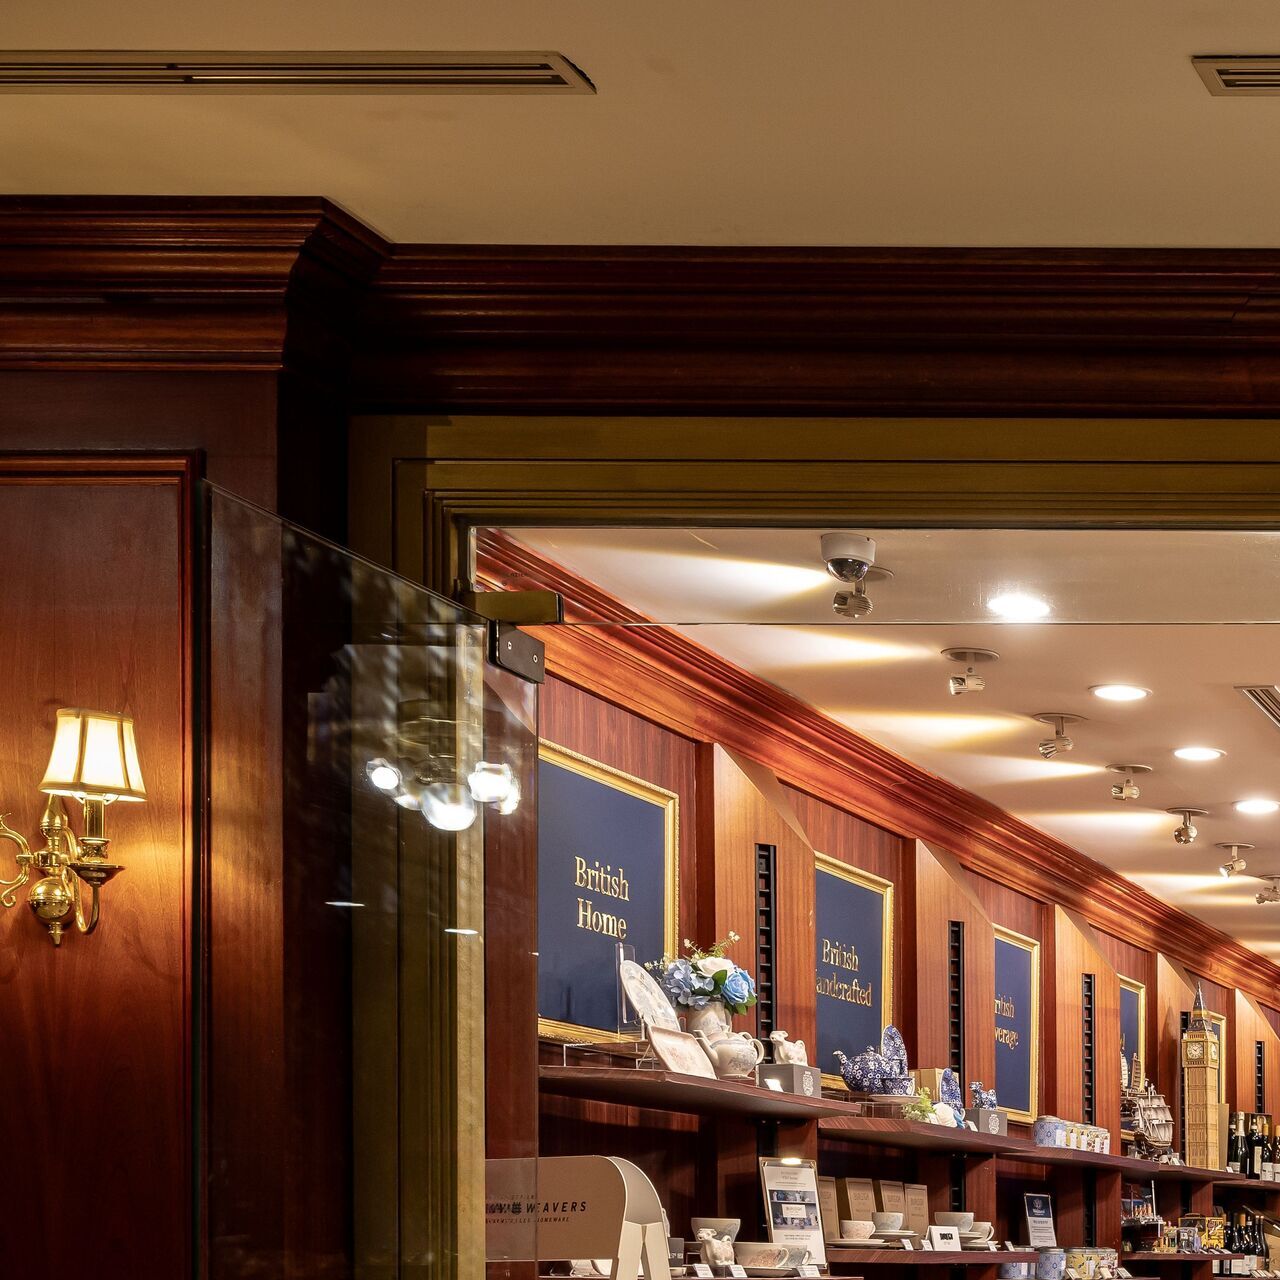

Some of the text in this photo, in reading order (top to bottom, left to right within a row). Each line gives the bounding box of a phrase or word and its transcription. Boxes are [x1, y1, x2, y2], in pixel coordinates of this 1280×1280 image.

[575, 855, 630, 901] British
[577, 897, 627, 940] Home
[822, 939, 859, 973] British
[816, 971, 873, 1008] andcrafted
[994, 994, 1015, 1019] ritish
[994, 1029, 1019, 1050] verage
